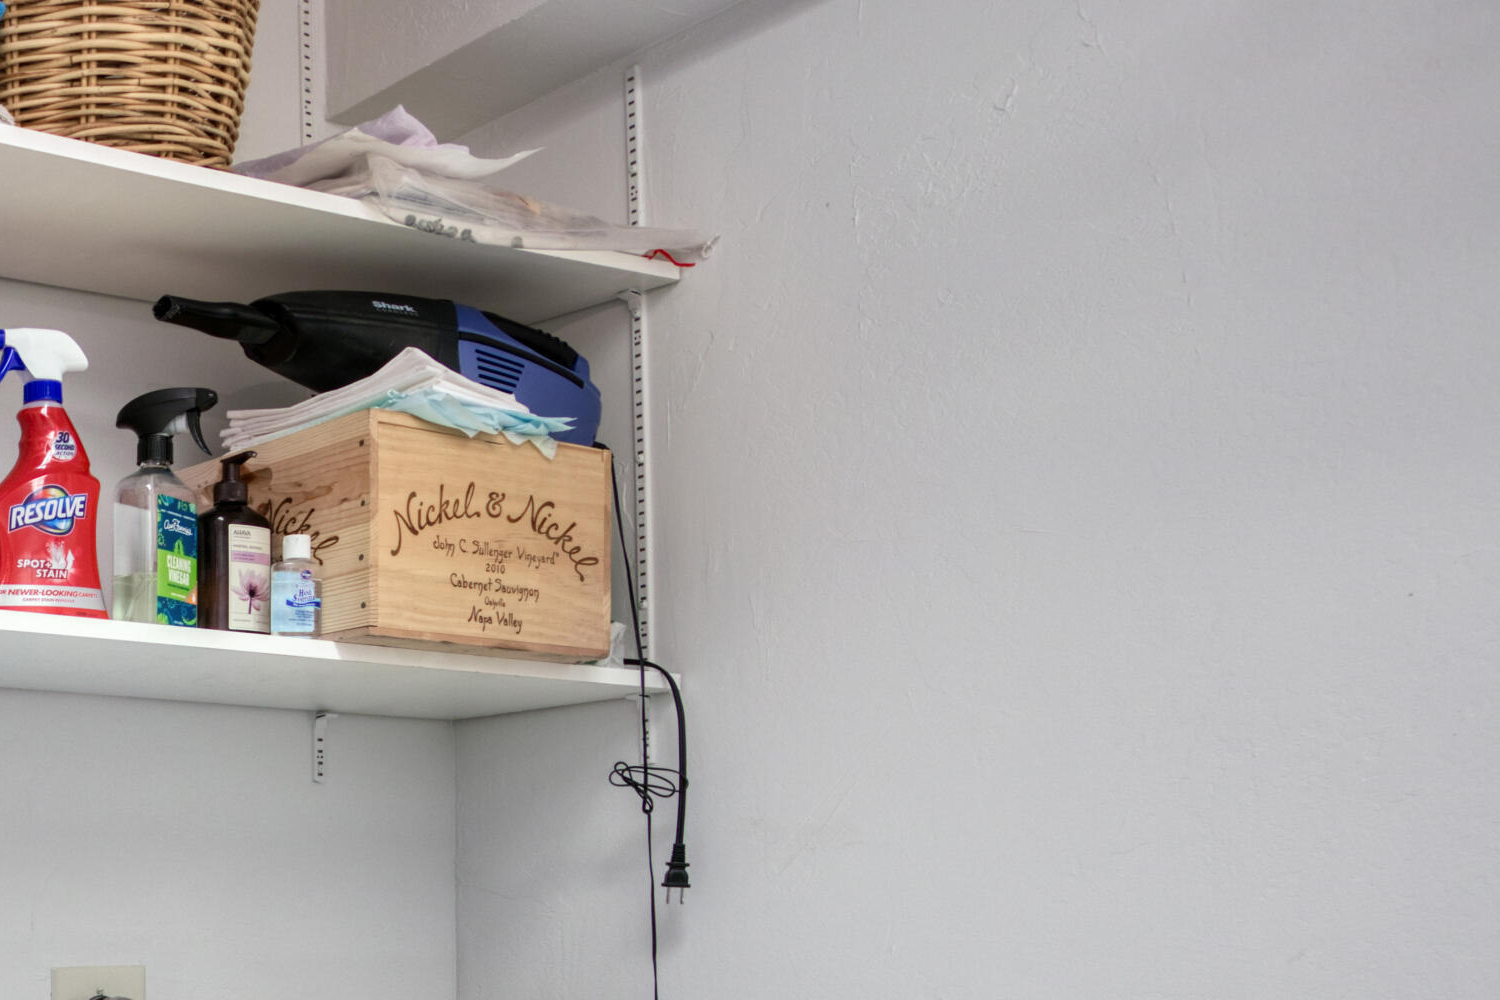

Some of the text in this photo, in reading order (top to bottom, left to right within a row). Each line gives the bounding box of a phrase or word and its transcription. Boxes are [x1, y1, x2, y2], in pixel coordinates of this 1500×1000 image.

[372, 300, 413, 312] Shark
[55, 431, 70, 443] 30
[10, 495, 86, 530] RESOLVE
[391, 481, 599, 583] Nickel & Nickel
[433, 535, 455, 557] John
[459, 538, 469, 554] C.
[516, 546, 557, 570] Vineyard
[166, 554, 192, 574] CLEANING
[485, 563, 506, 575] 2010
[35, 568, 68, 579] STAIN
[168, 571, 190, 587] VINEGAR
[7, 589, 78, 598] NEWER-LOOKING
[450, 573, 541, 603] Cabernet Sauvignon
[468, 605, 523, 635] Napa Valley
